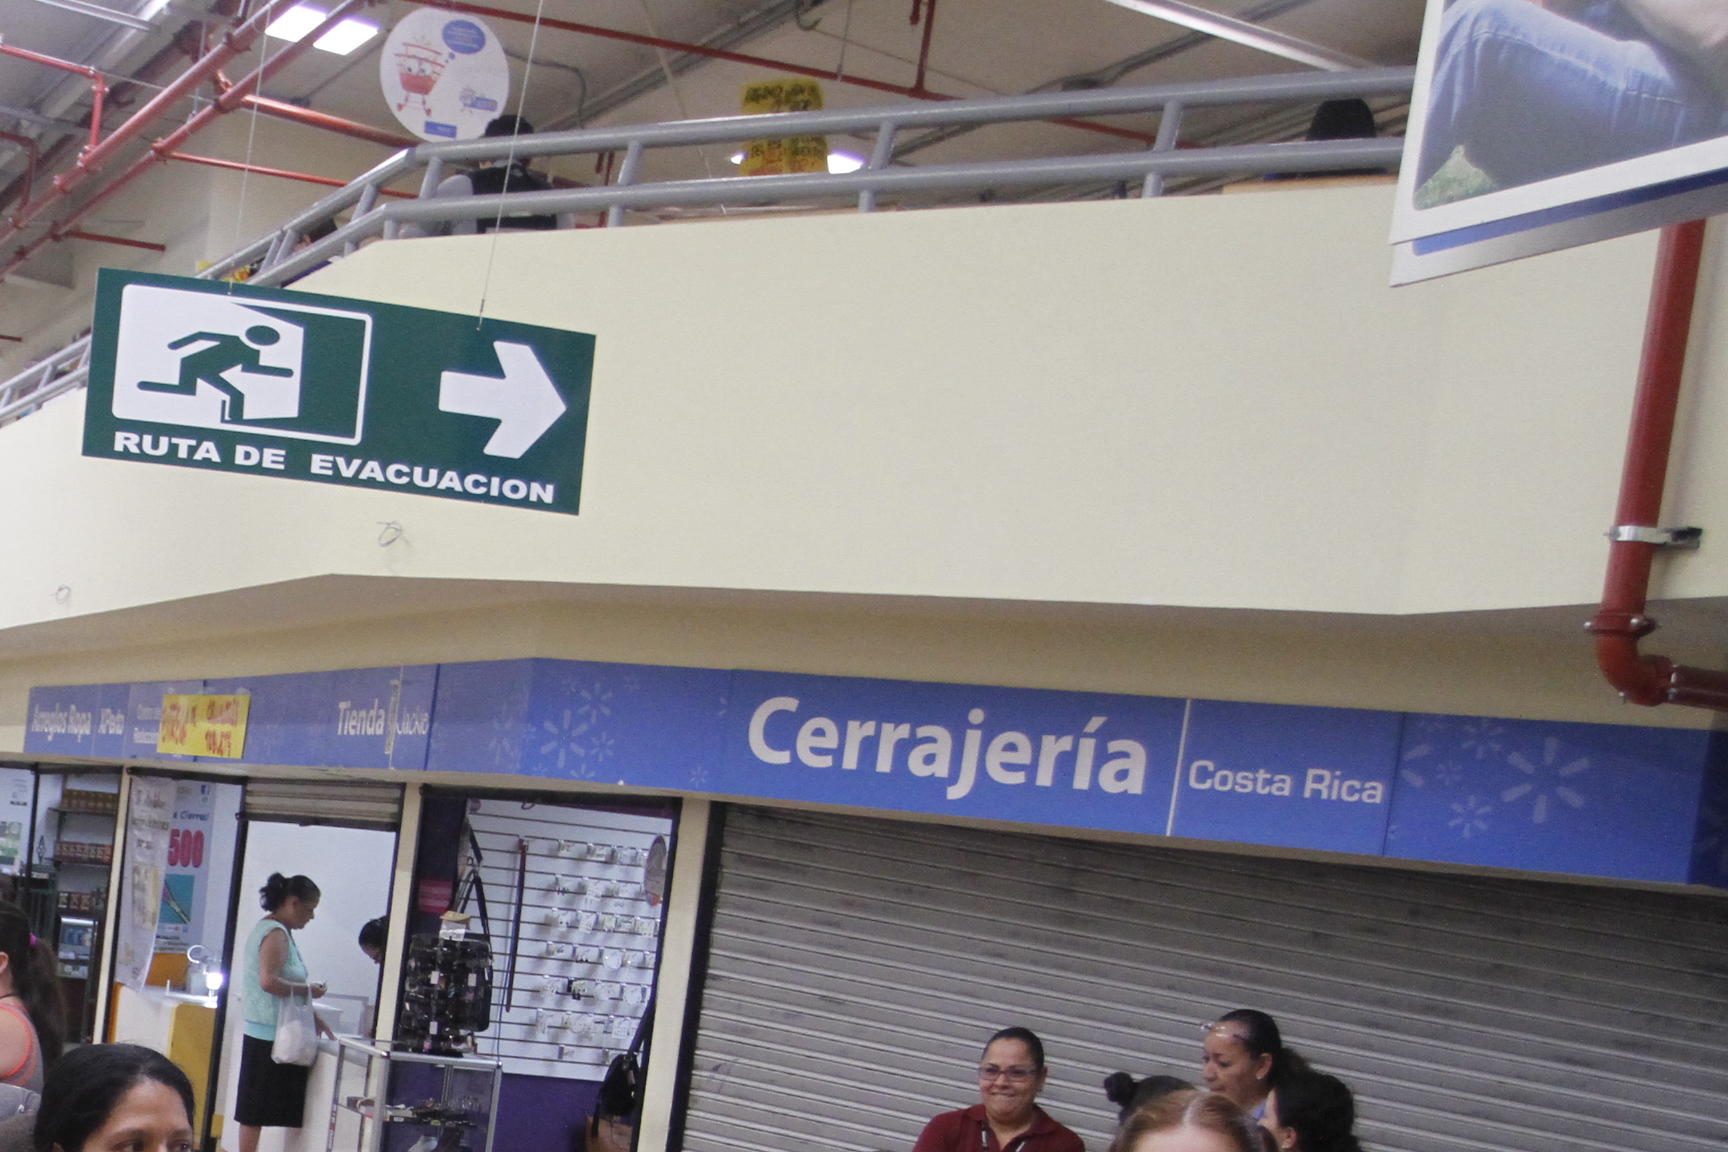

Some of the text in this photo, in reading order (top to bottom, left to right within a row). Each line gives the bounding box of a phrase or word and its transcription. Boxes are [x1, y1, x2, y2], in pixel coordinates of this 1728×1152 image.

[113, 430, 555, 504] RUTA DE EVACUACION
[32, 703, 68, 741] Arreglos
[337, 698, 386, 736] Tienda
[748, 696, 1148, 800] Cerrajería
[1188, 759, 1384, 804] Costa Rica
